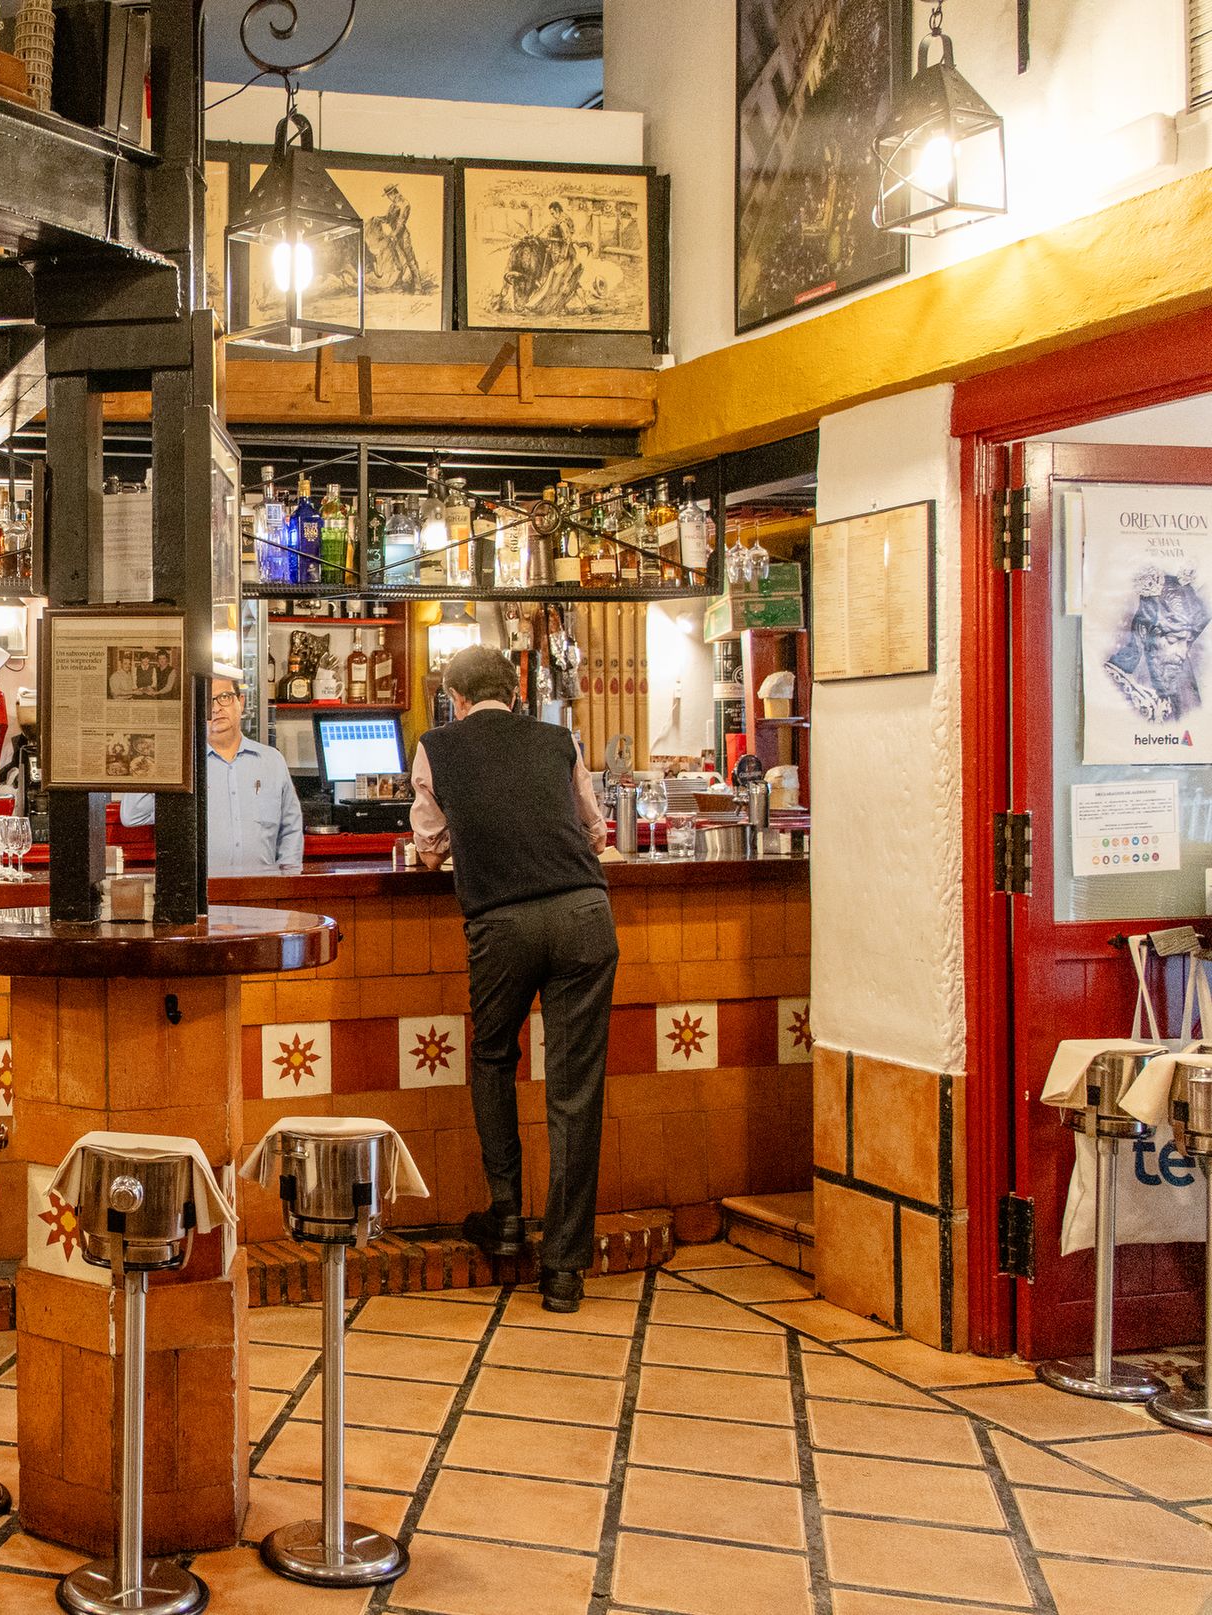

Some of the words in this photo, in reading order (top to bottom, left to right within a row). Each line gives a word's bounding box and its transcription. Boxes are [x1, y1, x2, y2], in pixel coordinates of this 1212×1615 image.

[1148, 537, 1180, 546] SEMANA
[1160, 548, 1185, 557] SANTA
[1134, 733, 1179, 745] helvetia
